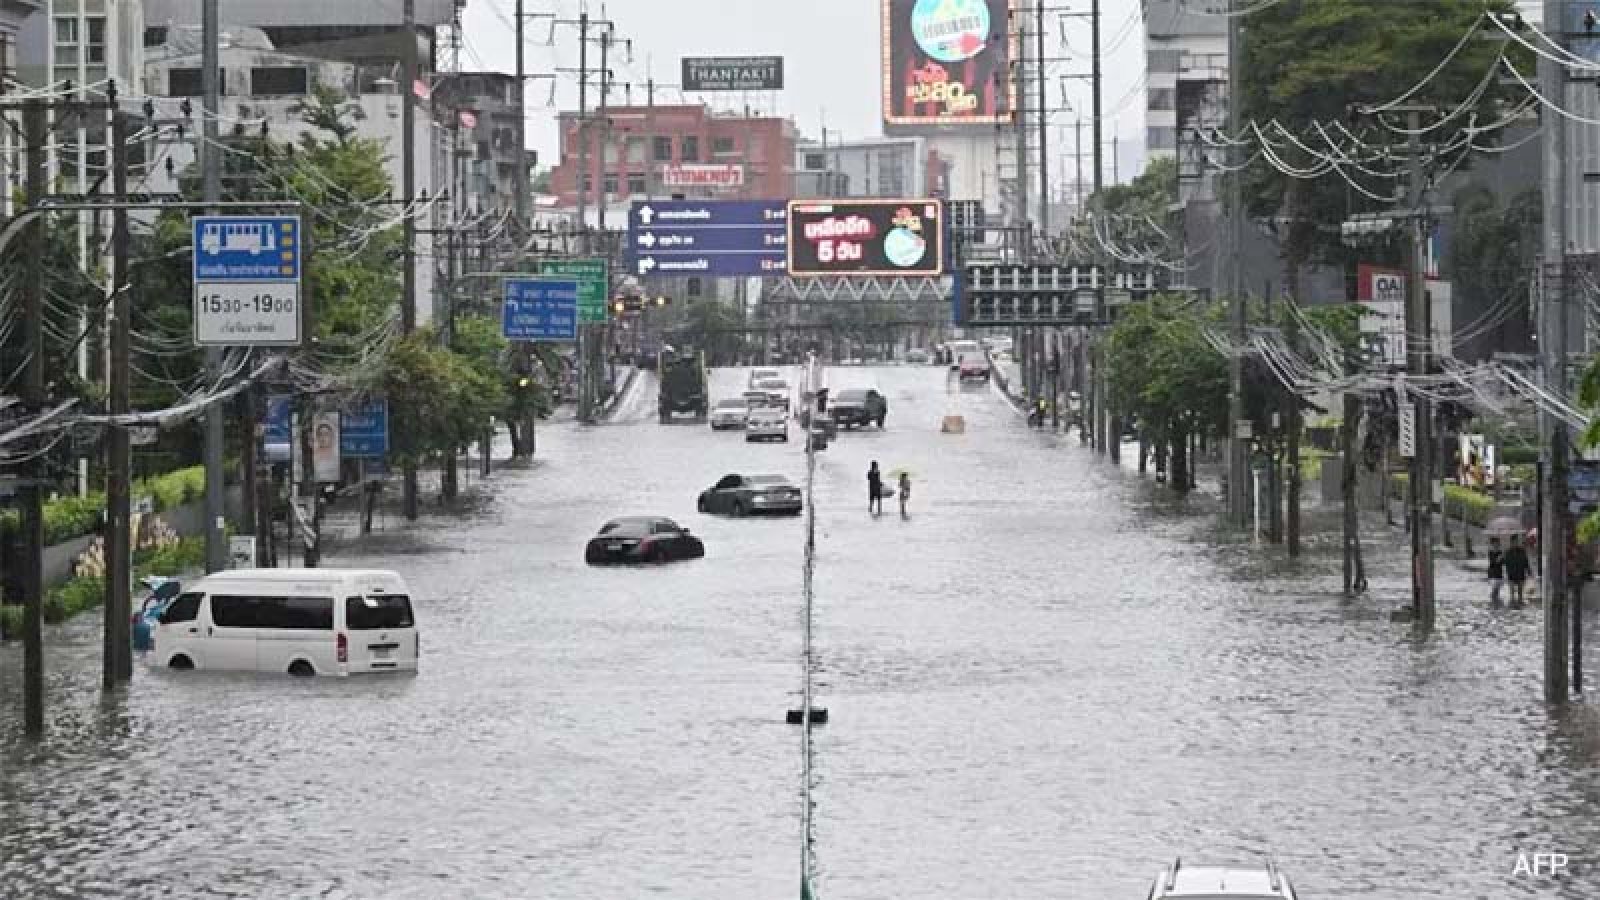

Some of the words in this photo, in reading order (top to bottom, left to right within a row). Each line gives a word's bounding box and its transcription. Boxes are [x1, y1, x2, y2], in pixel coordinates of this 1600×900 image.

[690, 67, 775, 81] THANTAKIT
[804, 215, 870, 238] เหลืออีก
[837, 241, 862, 260] วัน
